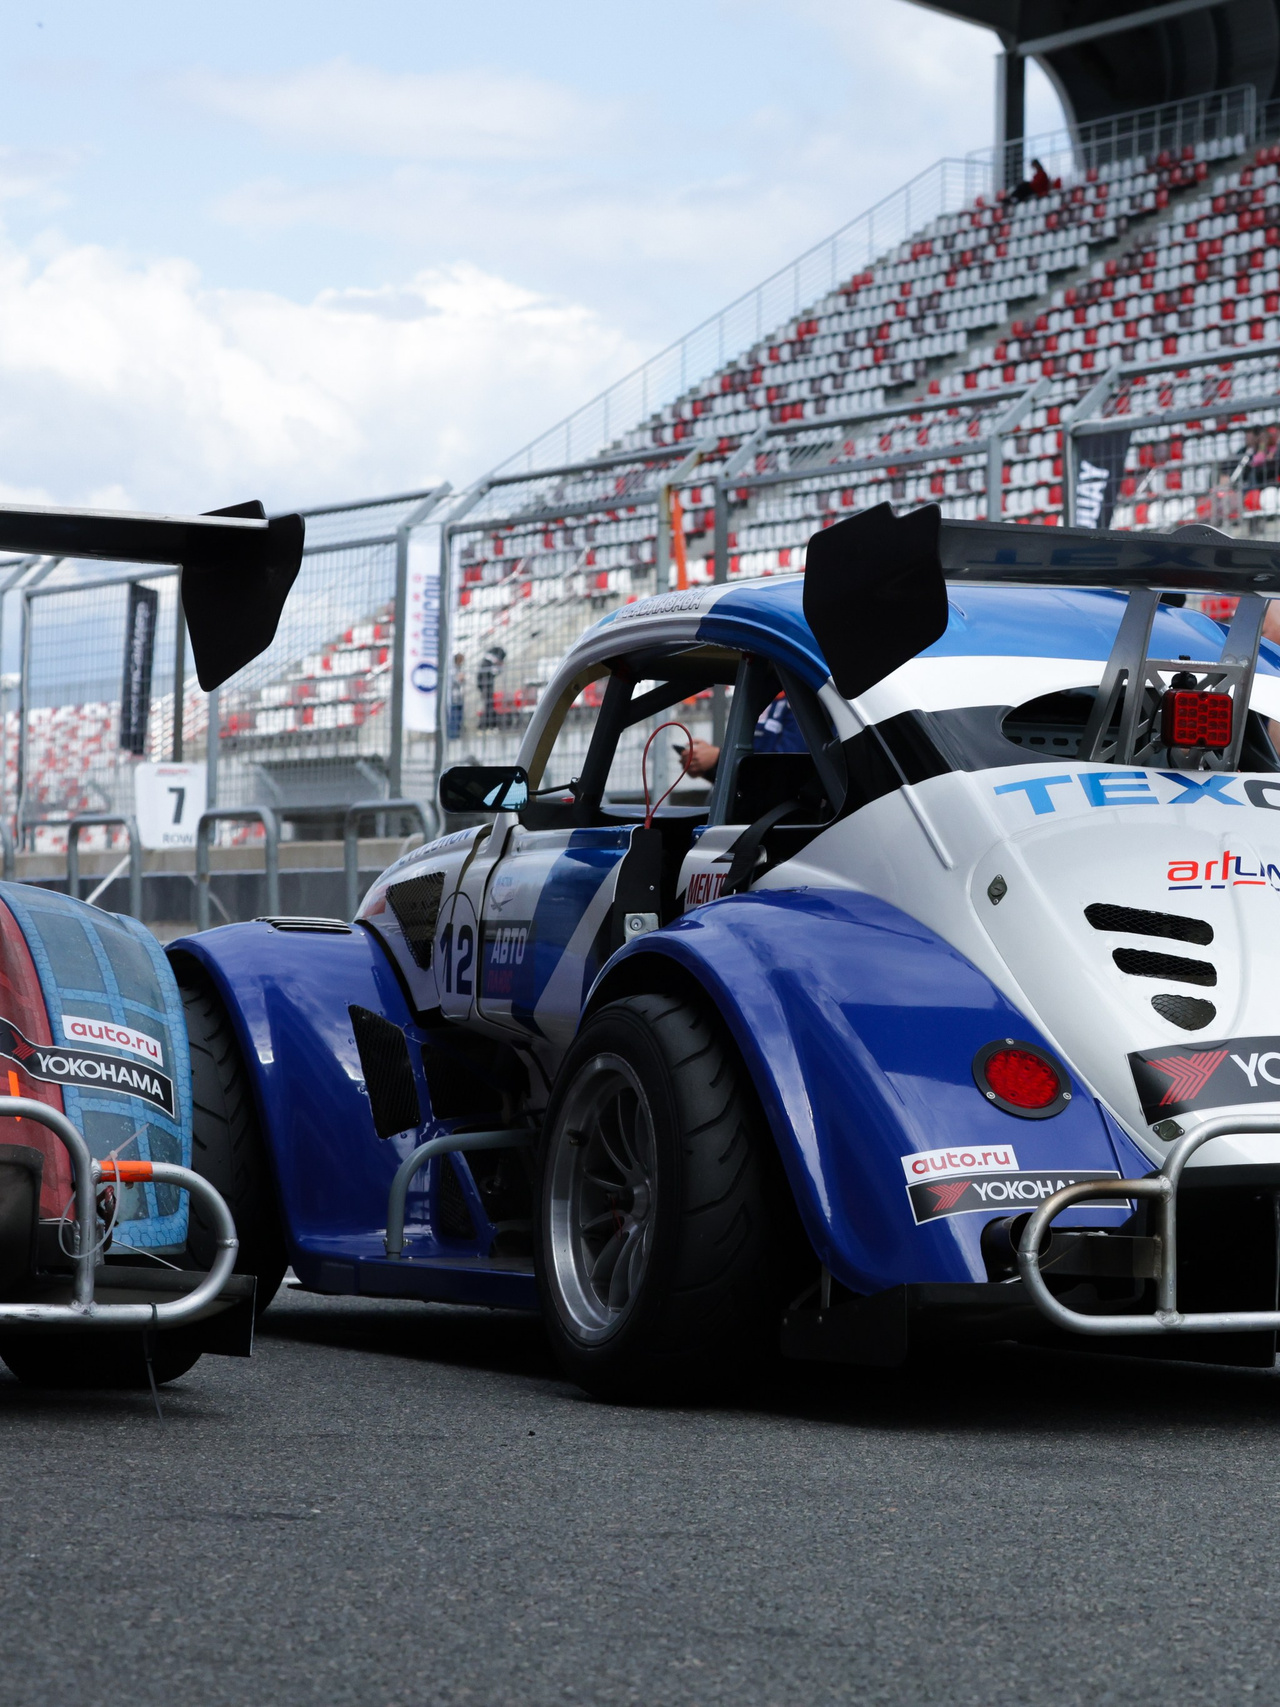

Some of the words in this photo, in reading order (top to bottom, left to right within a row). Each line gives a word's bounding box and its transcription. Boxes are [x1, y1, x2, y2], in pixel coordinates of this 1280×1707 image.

[167, 786, 186, 825] 7
[162, 833, 193, 844] ROW
[686, 873, 714, 904] MEN
[439, 922, 474, 996] 12
[490, 927, 528, 965] АВТО
[70, 1021, 158, 1058] auto.ru
[36, 1052, 165, 1101] YOKOHAMA
[911, 1150, 1011, 1175] auto.ru
